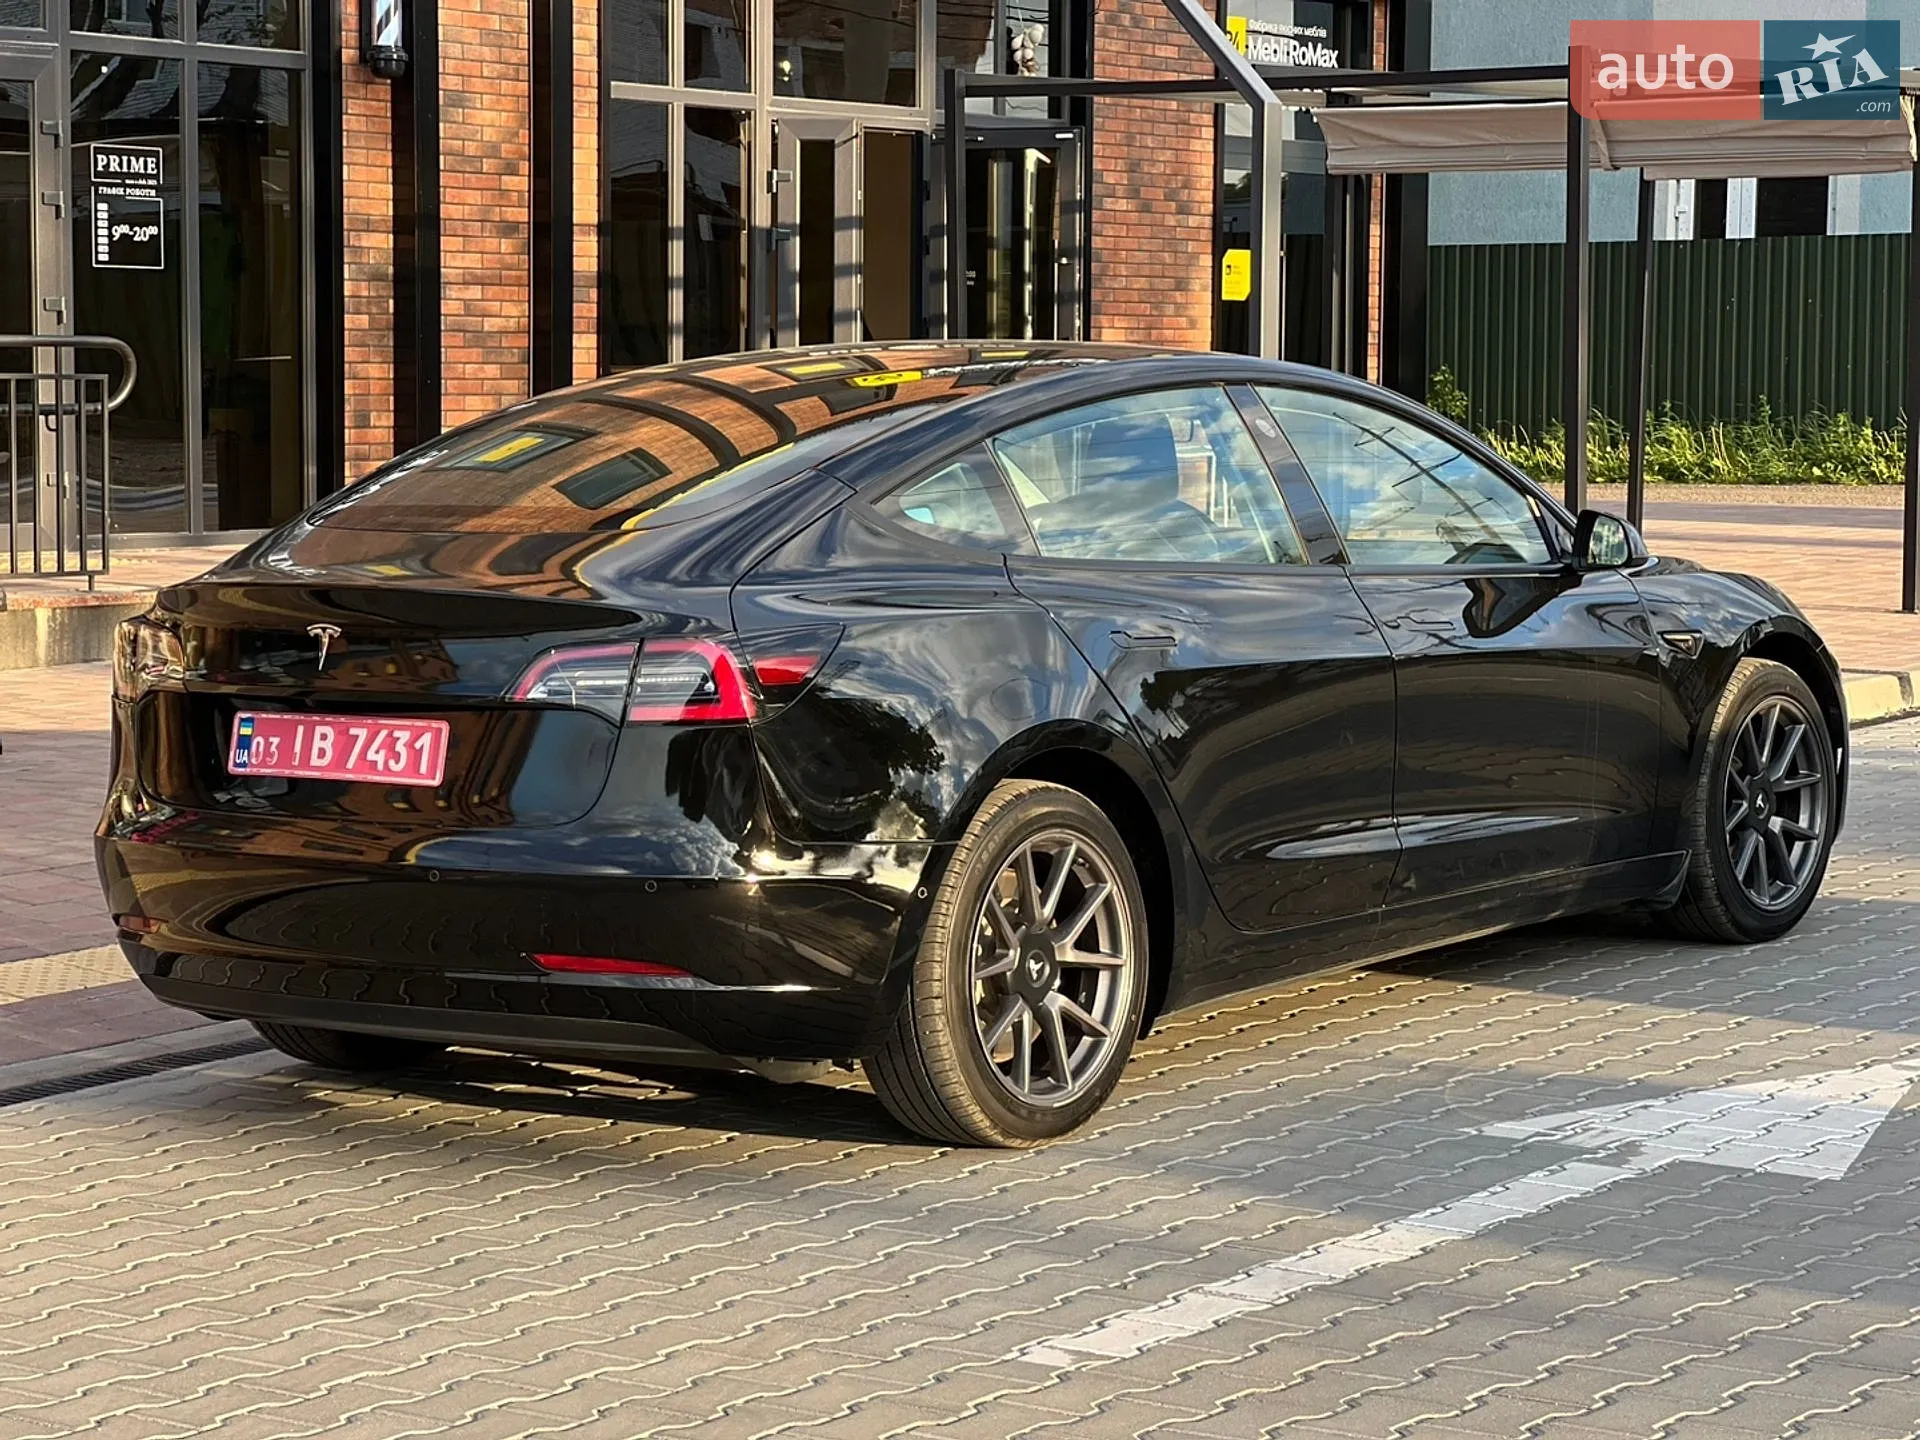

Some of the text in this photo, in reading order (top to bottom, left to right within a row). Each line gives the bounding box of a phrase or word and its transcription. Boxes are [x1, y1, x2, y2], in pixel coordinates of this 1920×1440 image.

[96, 154, 158, 174] PRIME
[235, 748, 249, 764] UA
[251, 736, 281, 766] 03
[345, 727, 432, 775] 7431
